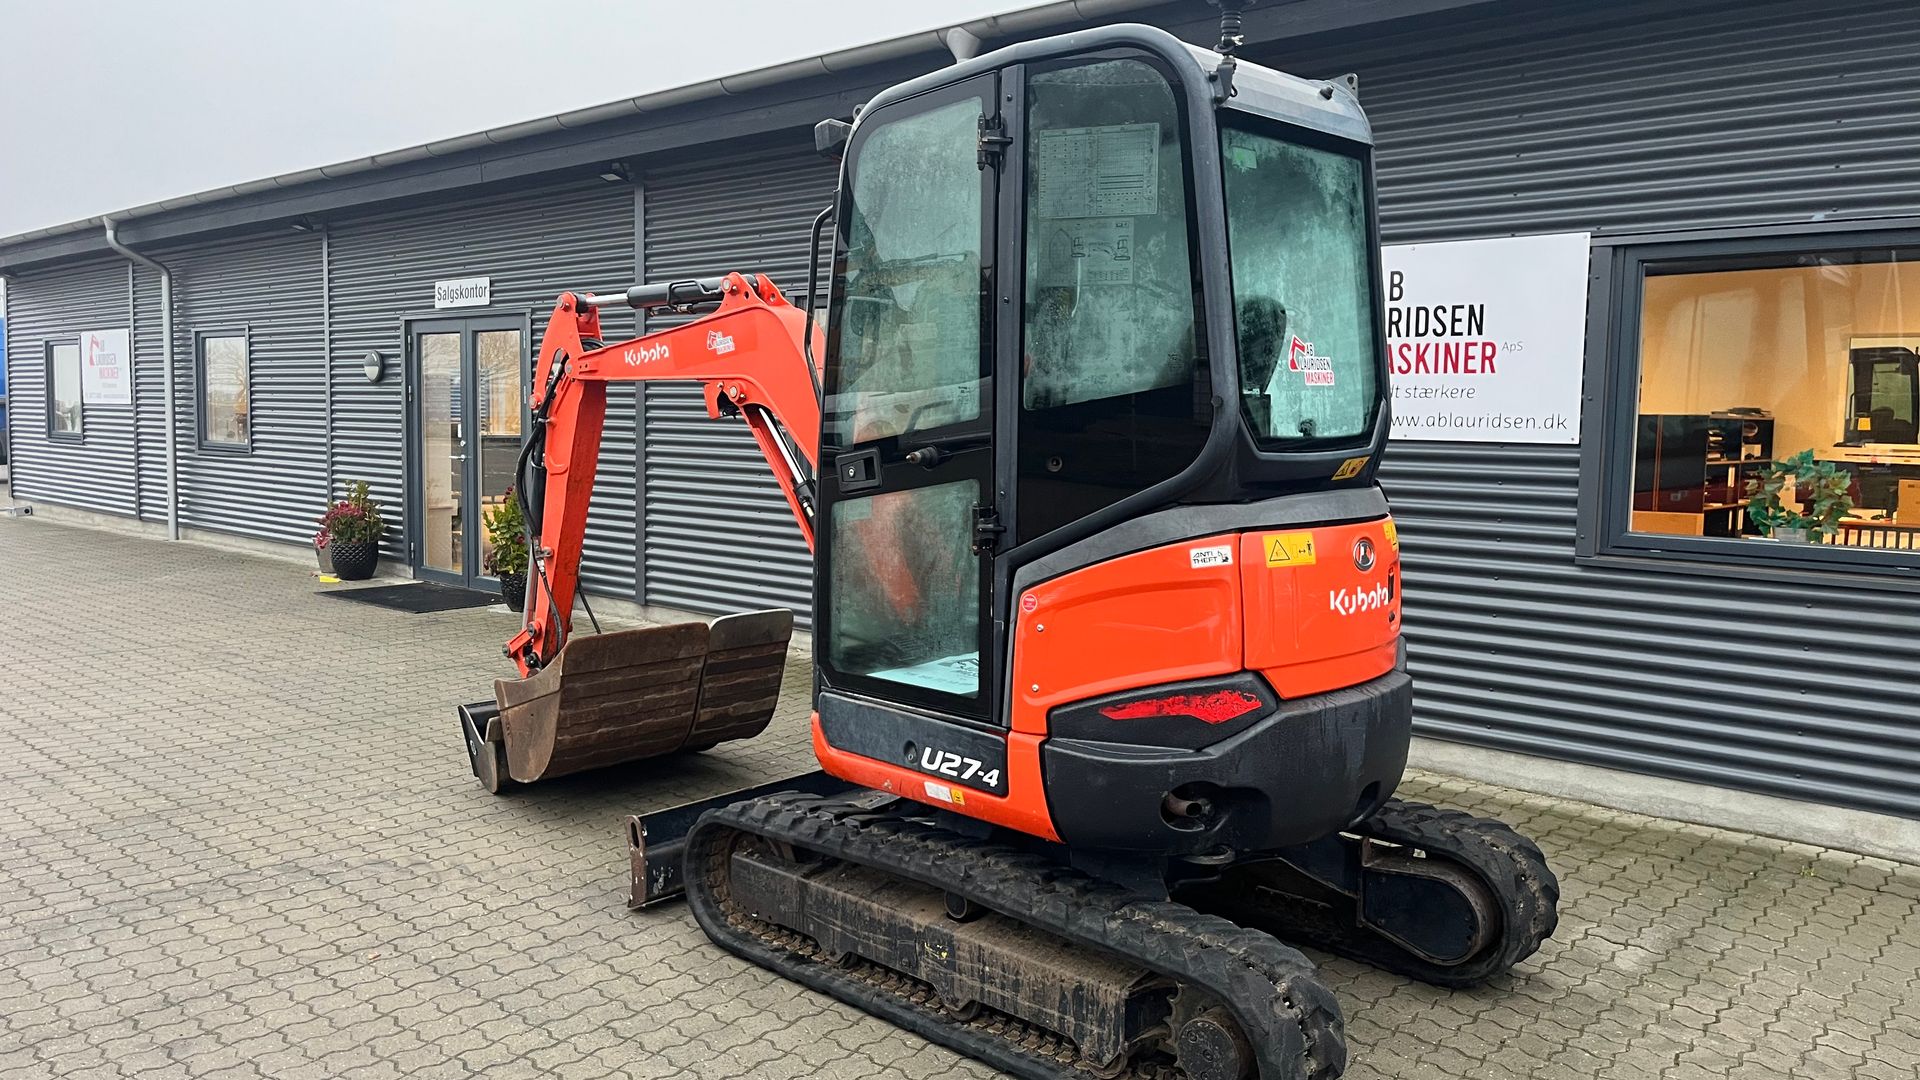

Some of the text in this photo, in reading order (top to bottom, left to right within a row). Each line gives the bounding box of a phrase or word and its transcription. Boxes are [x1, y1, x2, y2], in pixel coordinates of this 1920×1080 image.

[437, 283, 488, 303] Salgskontor
[1389, 270, 1404, 302] B
[1387, 303, 1485, 339] RIDSEN
[624, 342, 669, 366] Kubota
[1501, 340, 1524, 354] ApS
[1306, 371, 1334, 384] MASKINER
[1405, 384, 1476, 399] stærkere
[1391, 411, 1568, 430] ww.ablauridsen.dk
[1193, 550, 1214, 558] ANTI
[1193, 556, 1217, 564] THEFT
[1329, 582, 1389, 616] Kubota
[921, 746, 1000, 788] U27-4
